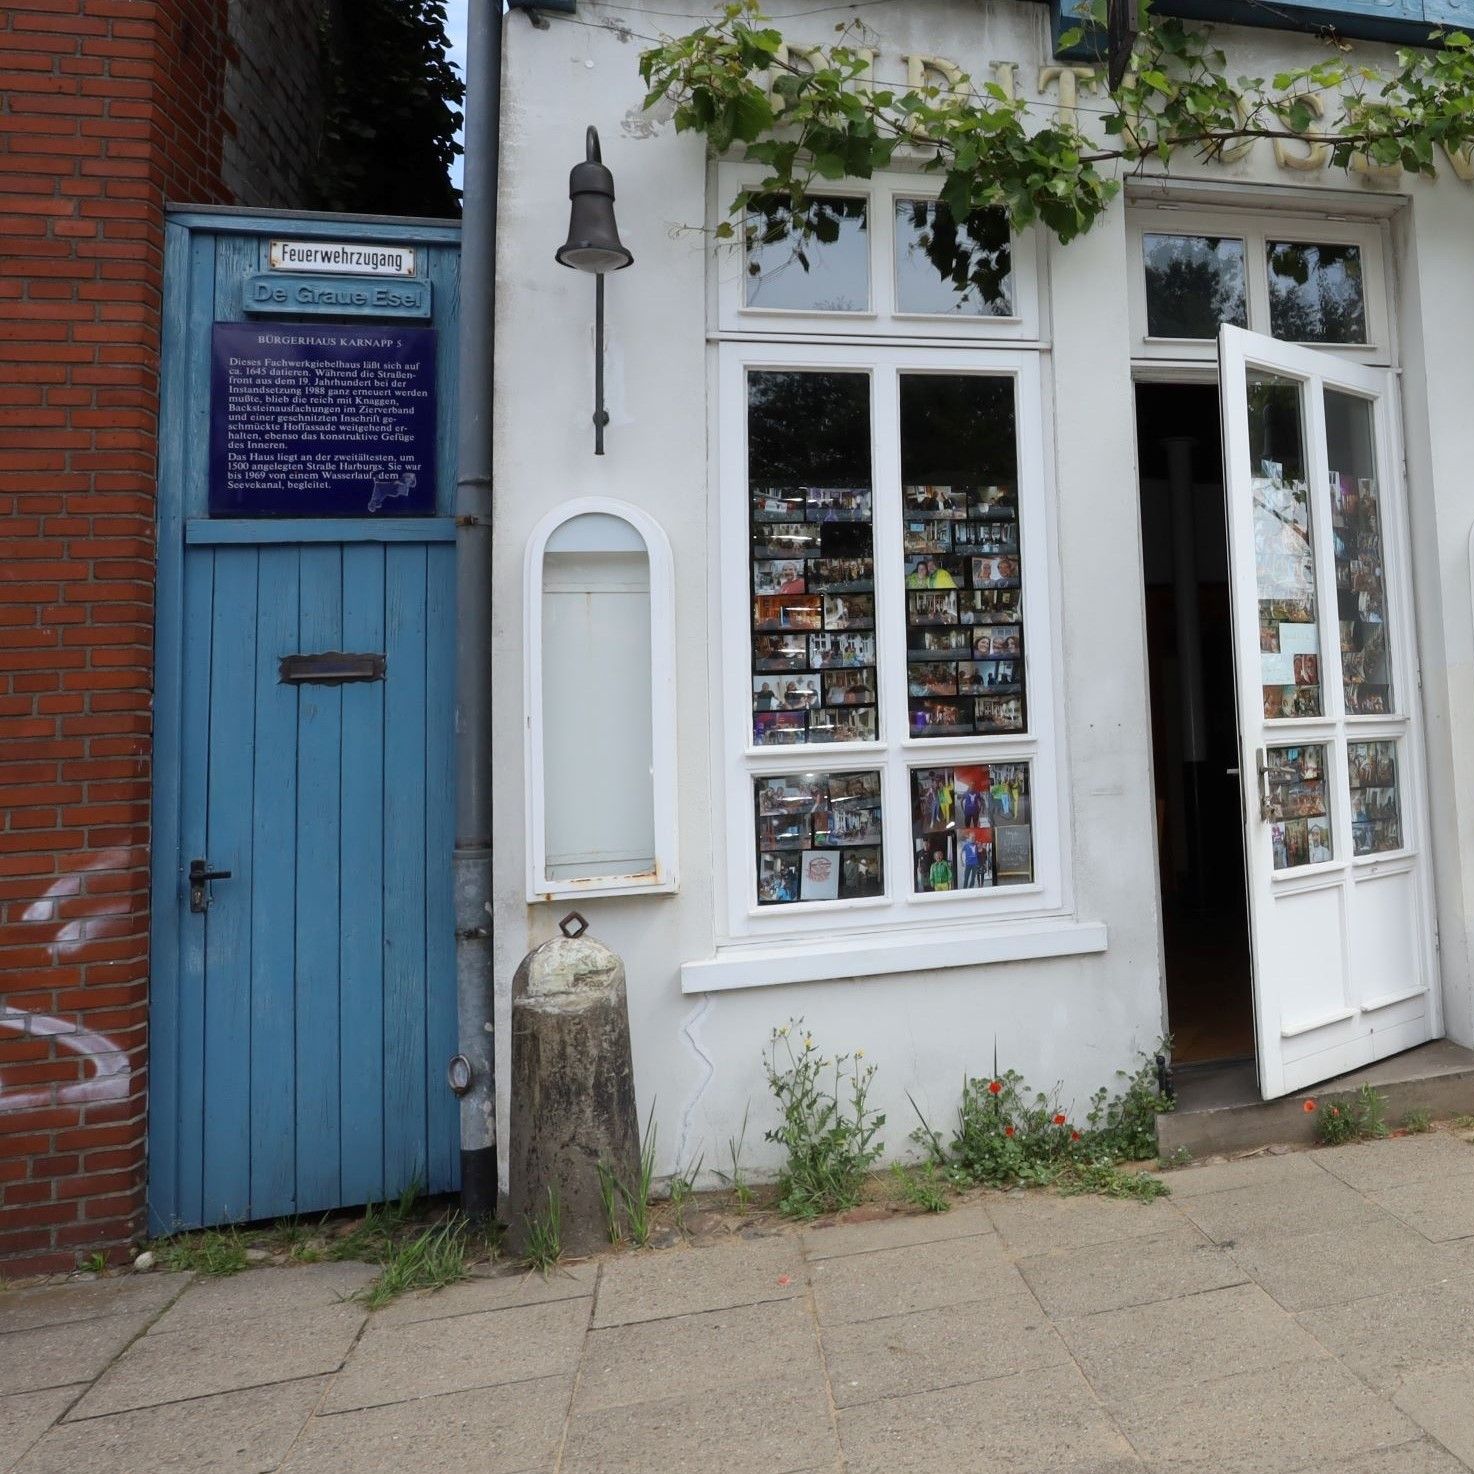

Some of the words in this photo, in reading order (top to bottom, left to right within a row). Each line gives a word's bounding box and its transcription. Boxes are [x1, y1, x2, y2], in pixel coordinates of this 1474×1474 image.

[281, 244, 403, 272] Feuerwehrzugang
[254, 282, 288, 302] De
[295, 284, 369, 306] Graue
[372, 287, 422, 308] Esel
[258, 334, 337, 346] BÜRGERHAUS
[340, 338, 394, 348] KARNAPP
[230, 358, 261, 366] Dieses
[265, 358, 361, 369] Fachwerkgiebelhaus
[363, 360, 380, 369] läßt
[383, 362, 402, 370] sich
[404, 362, 421, 370] auf
[246, 367, 267, 375] 1645
[315, 369, 358, 378] Während
[360, 370, 375, 378] die
[229, 376, 253, 384] front
[274, 377, 296, 385] dem
[314, 378, 371, 387] Jahrhundert
[391, 380, 407, 388] der
[229, 386, 302, 395] Instandsetzung
[305, 387, 325, 395] 1988
[394, 389, 428, 397] werden
[265, 395, 290, 403] blieb
[292, 396, 308, 404] die
[310, 396, 334, 404] reich
[228, 404, 341, 414] Backsteinausfachungen
[359, 406, 415, 415] Zierverband
[228, 413, 247, 421] und
[277, 414, 338, 423] geschnitzten
[341, 414, 381, 423] Inschrift
[228, 422, 281, 431] schmückte
[283, 423, 337, 431] Hoffassade
[339, 424, 393, 433] weitgehend
[264, 432, 299, 440] ebenso
[301, 432, 318, 440] das
[320, 433, 379, 441] konstruktive
[381, 433, 415, 442] Gefüge
[228, 441, 245, 449] des
[228, 453, 247, 461] Das
[249, 453, 275, 461] Haus
[277, 453, 299, 462] liegt
[315, 453, 332, 461] der
[228, 462, 250, 470] 1500
[251, 462, 304, 471] angelegten
[306, 462, 337, 471] Straße
[387, 462, 402, 470] Sie
[227, 471, 242, 479] bis
[245, 471, 266, 479] 1969
[378, 471, 399, 479] dem
